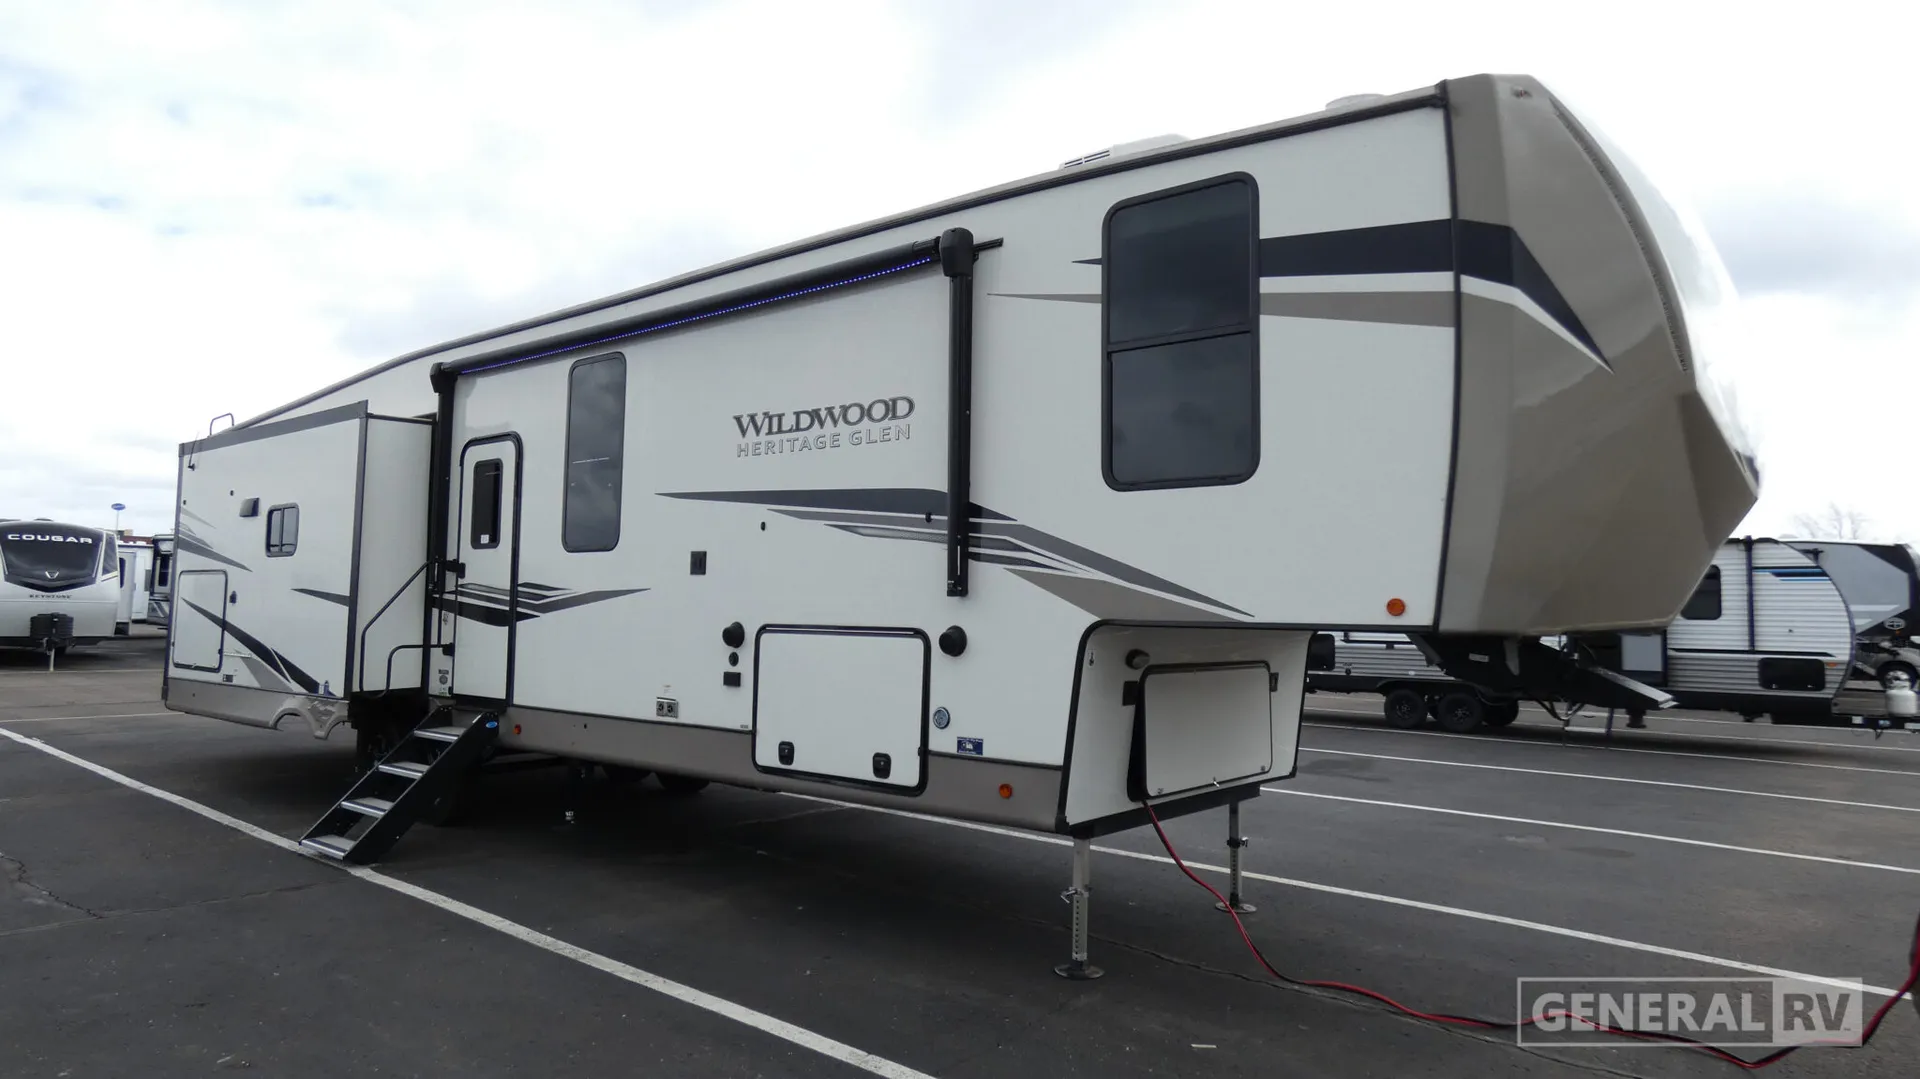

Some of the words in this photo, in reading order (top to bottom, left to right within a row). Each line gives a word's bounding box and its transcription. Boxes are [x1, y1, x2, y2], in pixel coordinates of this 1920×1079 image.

[733, 396, 915, 438] WILDWOOD
[737, 432, 841, 458] HERITAGE
[848, 423, 911, 446] GLEN
[7, 533, 93, 544] COUGAR
